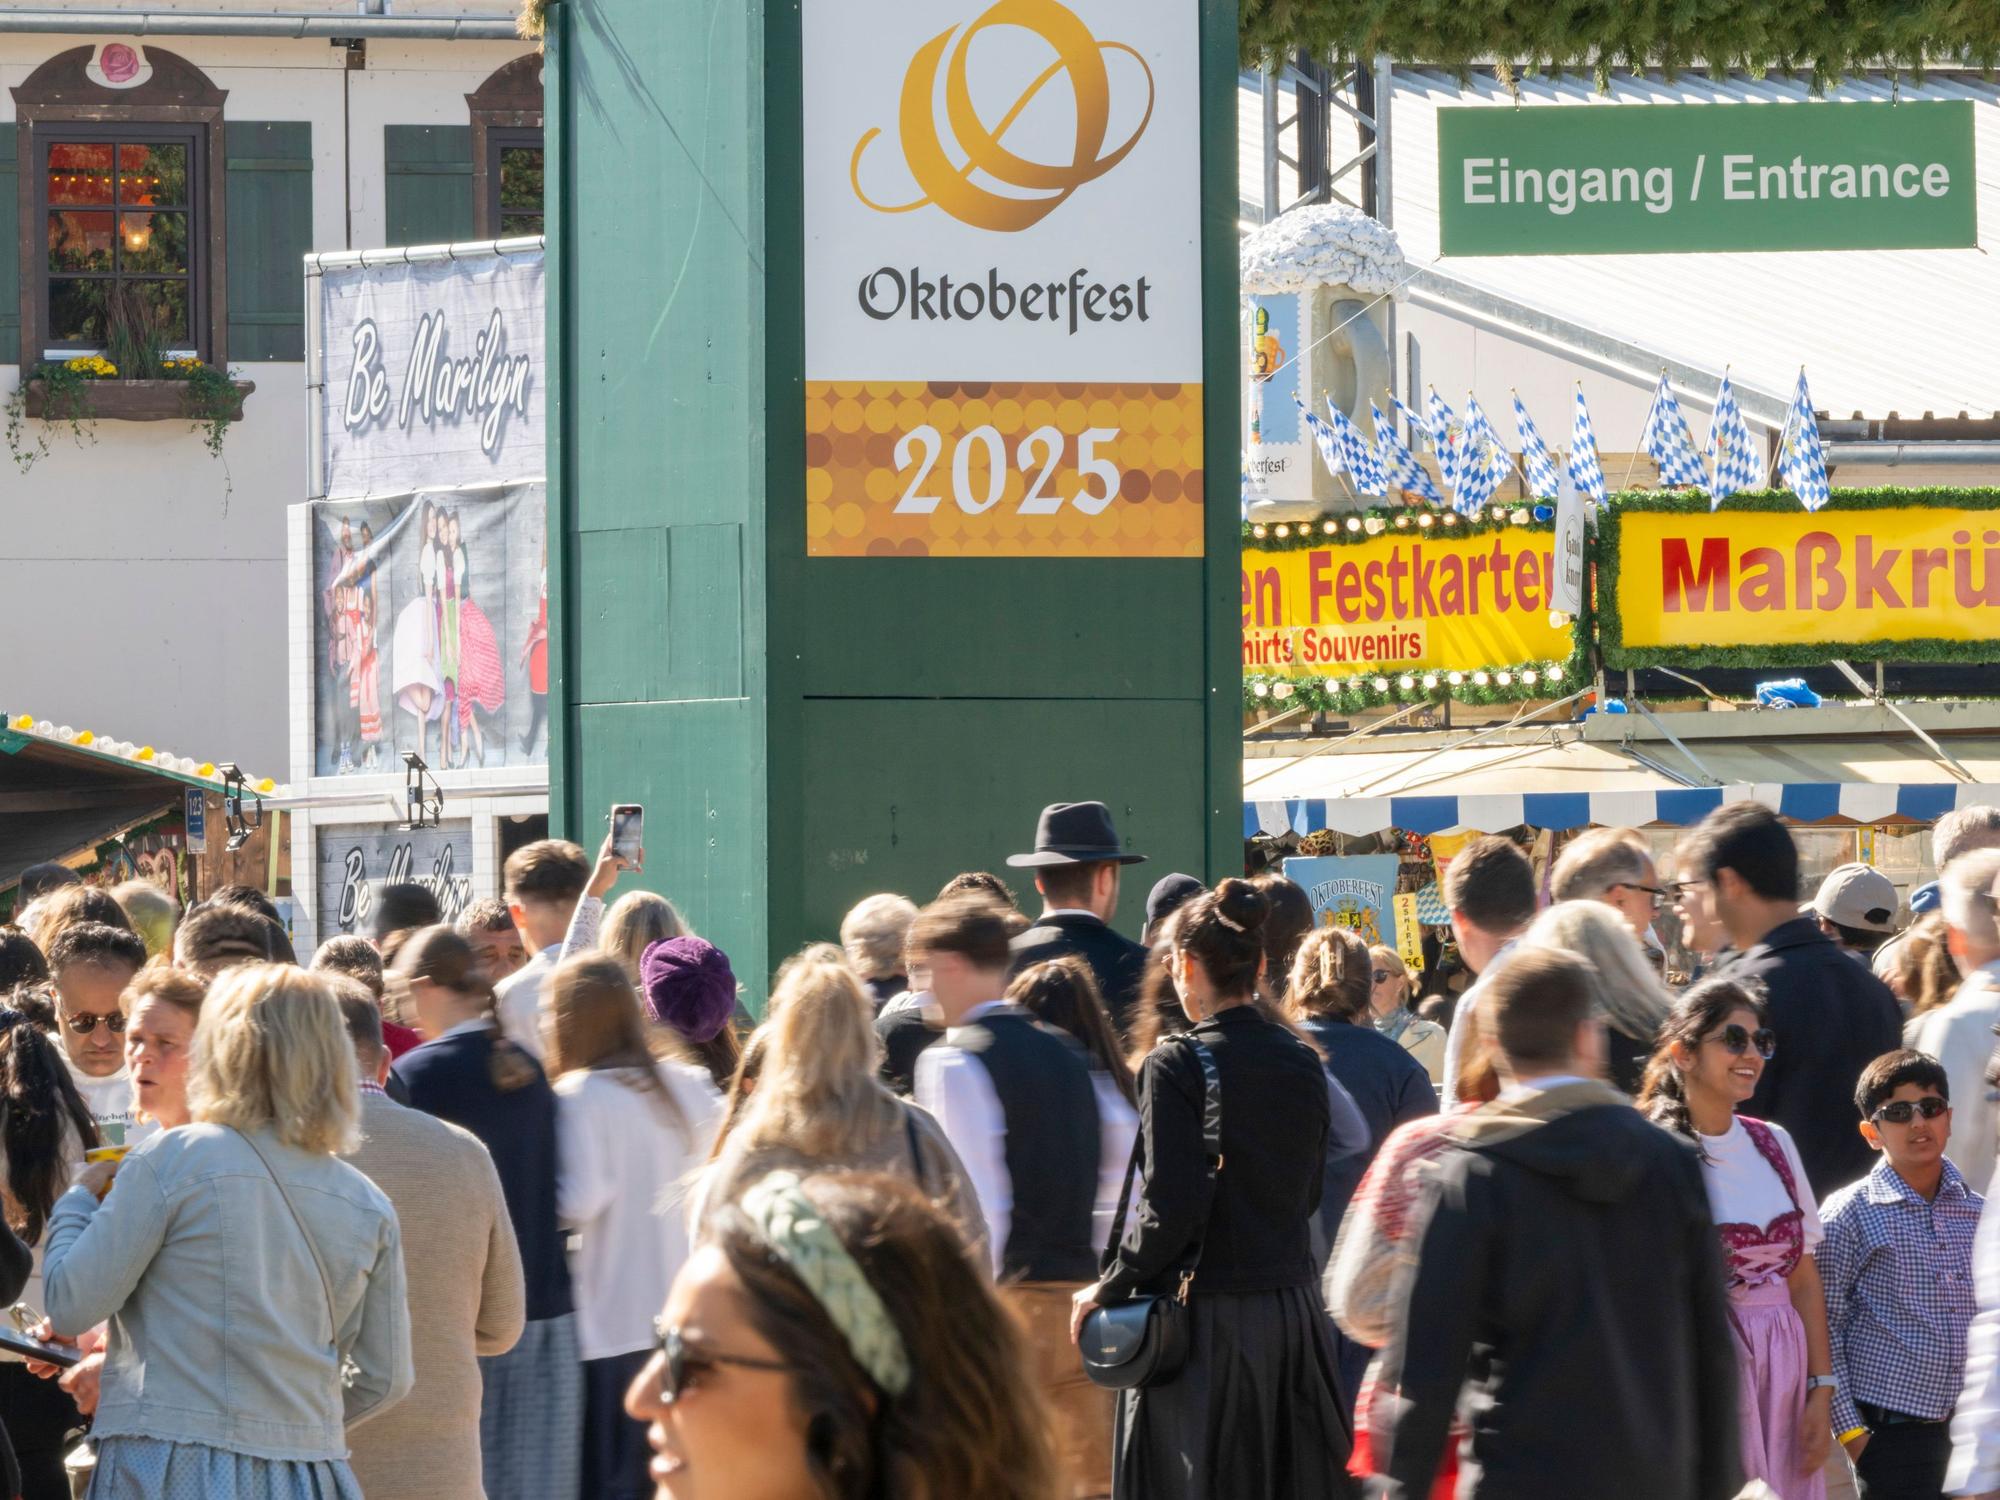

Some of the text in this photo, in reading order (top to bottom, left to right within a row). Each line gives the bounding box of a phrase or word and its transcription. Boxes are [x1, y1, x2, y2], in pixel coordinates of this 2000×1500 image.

[1462, 153, 1951, 216] Eingang / Entrance
[857, 265, 1153, 336] Oktoberfest
[344, 307, 530, 456] Be Marilyn
[891, 423, 1122, 516] 2025
[1661, 529, 2000, 613] Maßkrü
[1302, 625, 1422, 663] Souvenirs
[189, 796, 203, 816] 123
[338, 845, 372, 928] Be
[1310, 878, 1384, 912] OKTOBERFEST
[1401, 897, 1422, 969] 2 SHIRTS 5€
